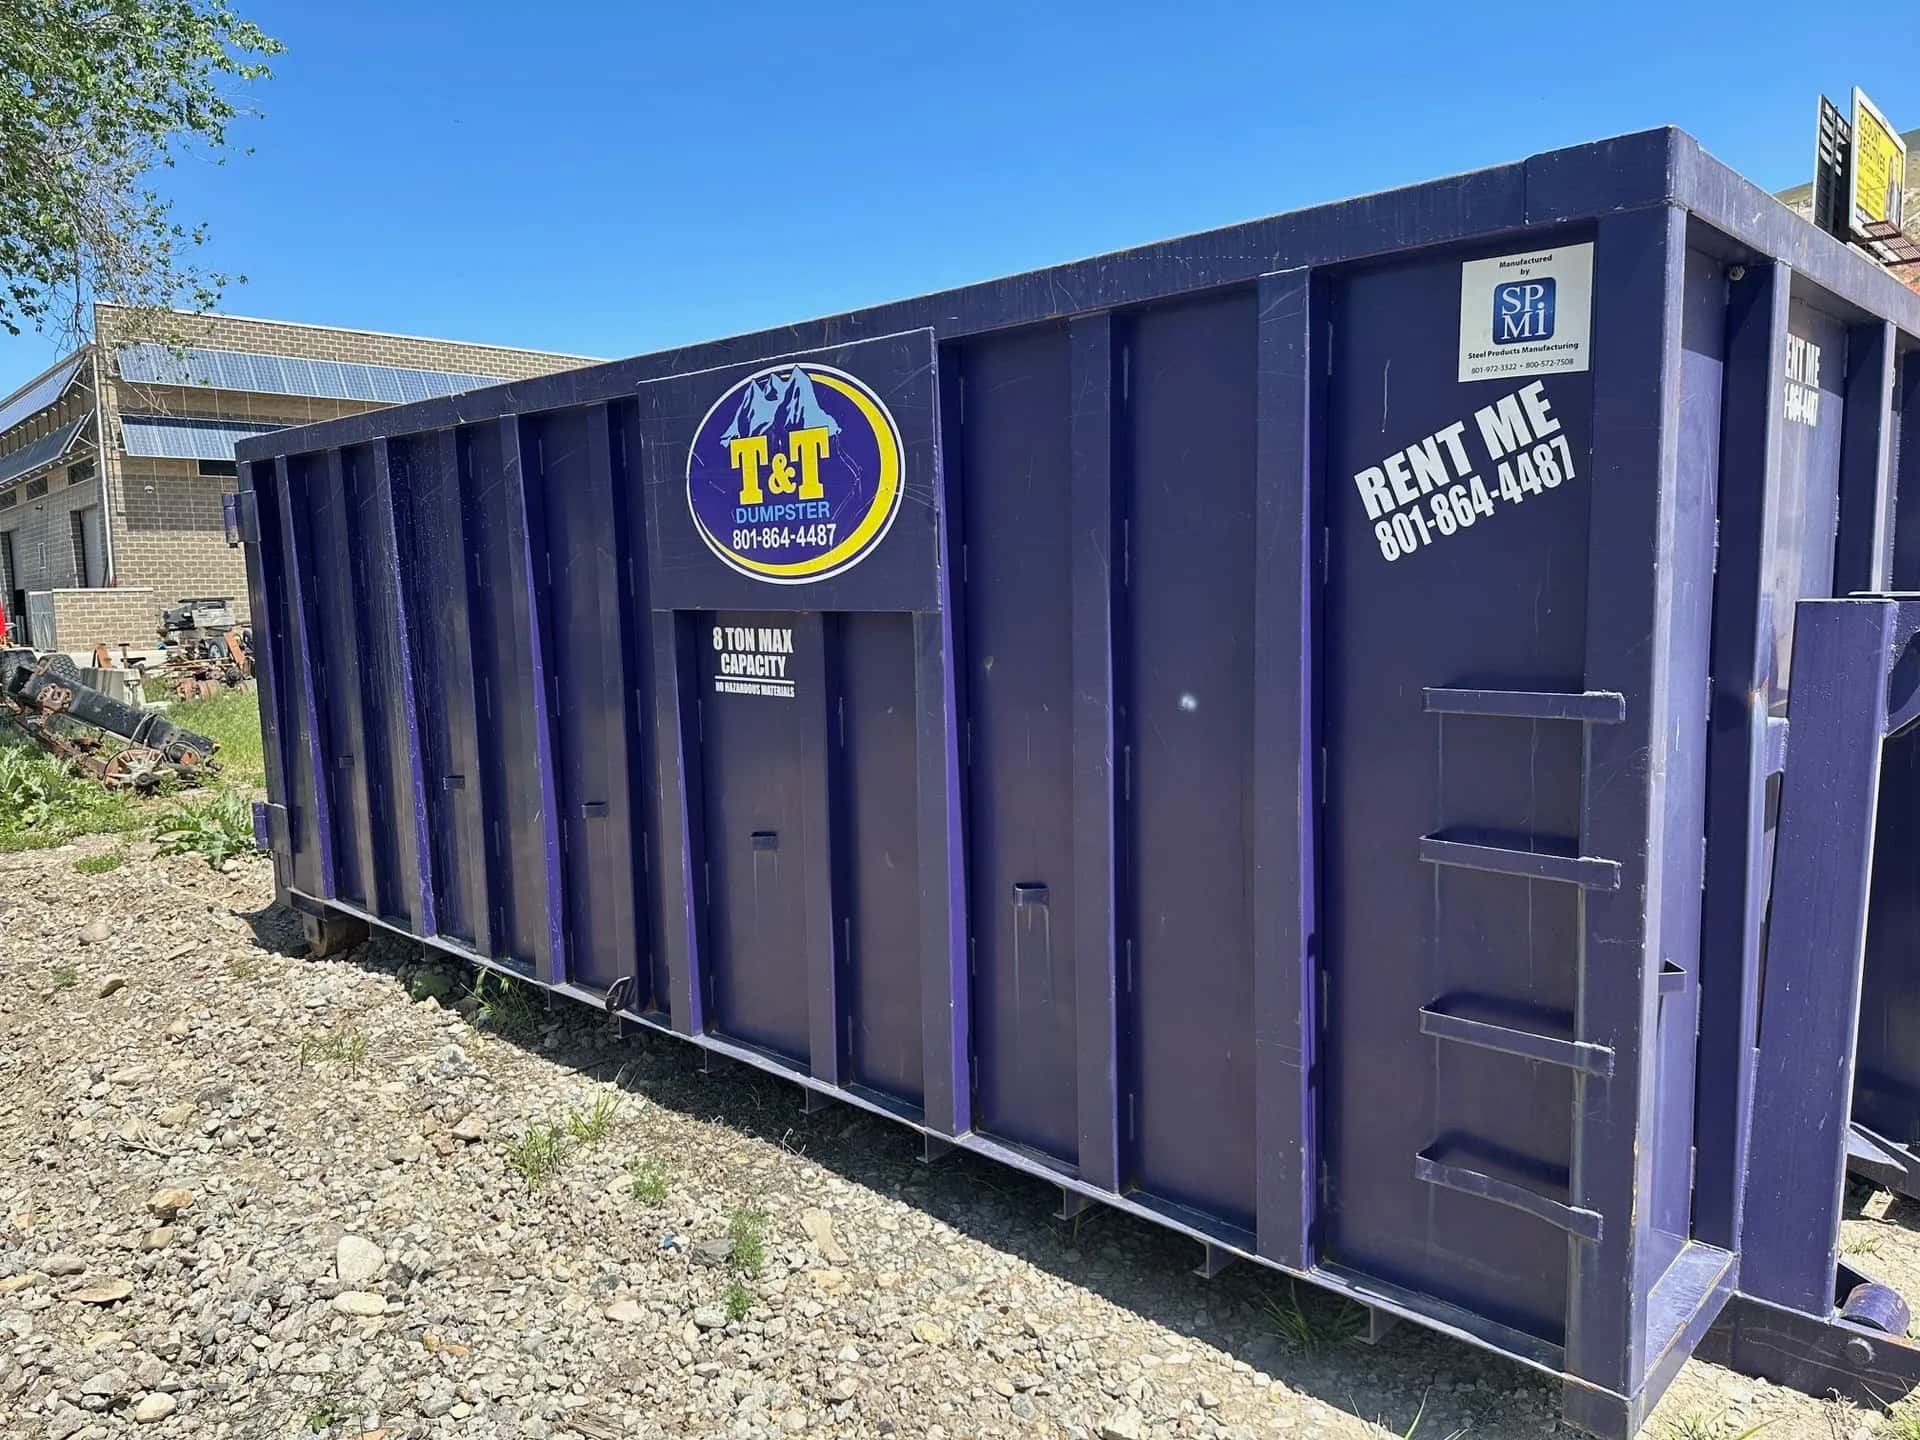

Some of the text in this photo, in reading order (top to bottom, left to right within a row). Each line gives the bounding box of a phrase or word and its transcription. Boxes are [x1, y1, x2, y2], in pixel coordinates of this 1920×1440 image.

[1500, 254, 1552, 268] Manufactured
[1520, 268, 1530, 276] by
[1488, 348, 1520, 357] Products
[1522, 342, 1579, 353] Manufacturing
[1784, 332, 1821, 388] ENT ME
[1472, 363, 1517, 374] 801-972-3322
[1354, 380, 1561, 520] RENT ME
[730, 426, 830, 505] T&T
[1374, 434, 1576, 562] 801-864-4487
[736, 501, 830, 524] DUMPSTER
[732, 524, 836, 550] 801-864-4487
[712, 626, 794, 654] 8 TON MAX
[720, 652, 786, 677] CAPACITY
[716, 681, 795, 698] NO HAZARDOUS MATERIALS
